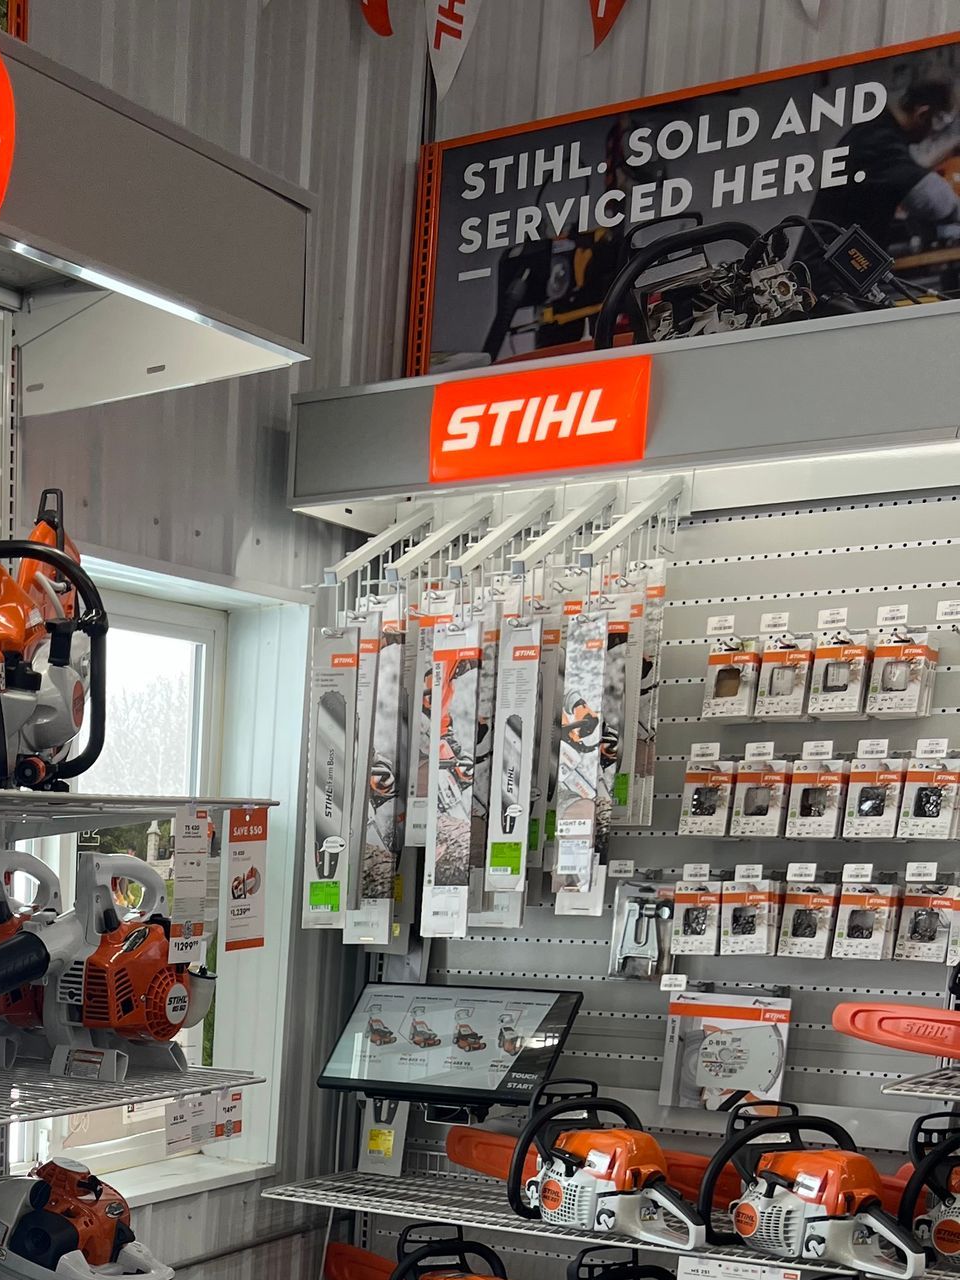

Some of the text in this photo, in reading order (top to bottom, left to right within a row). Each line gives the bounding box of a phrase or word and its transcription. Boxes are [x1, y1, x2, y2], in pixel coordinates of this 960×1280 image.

[461, 81, 888, 200] STIHL. SOLD AND
[459, 147, 866, 254] SERVICED HERE.
[442, 389, 617, 452] STIHL
[514, 649, 537, 657] STIHL
[506, 766, 515, 794] STIHL
[325, 788, 334, 818] STIHL
[233, 825, 262, 836] SAVE $50
[167, 995, 188, 1005] STIHL
[764, 1012, 787, 1020] STIHL
[511, 1072, 538, 1080] TOUCH
[542, 1187, 560, 1198] STIHL
[735, 1211, 755, 1221] STIHL
